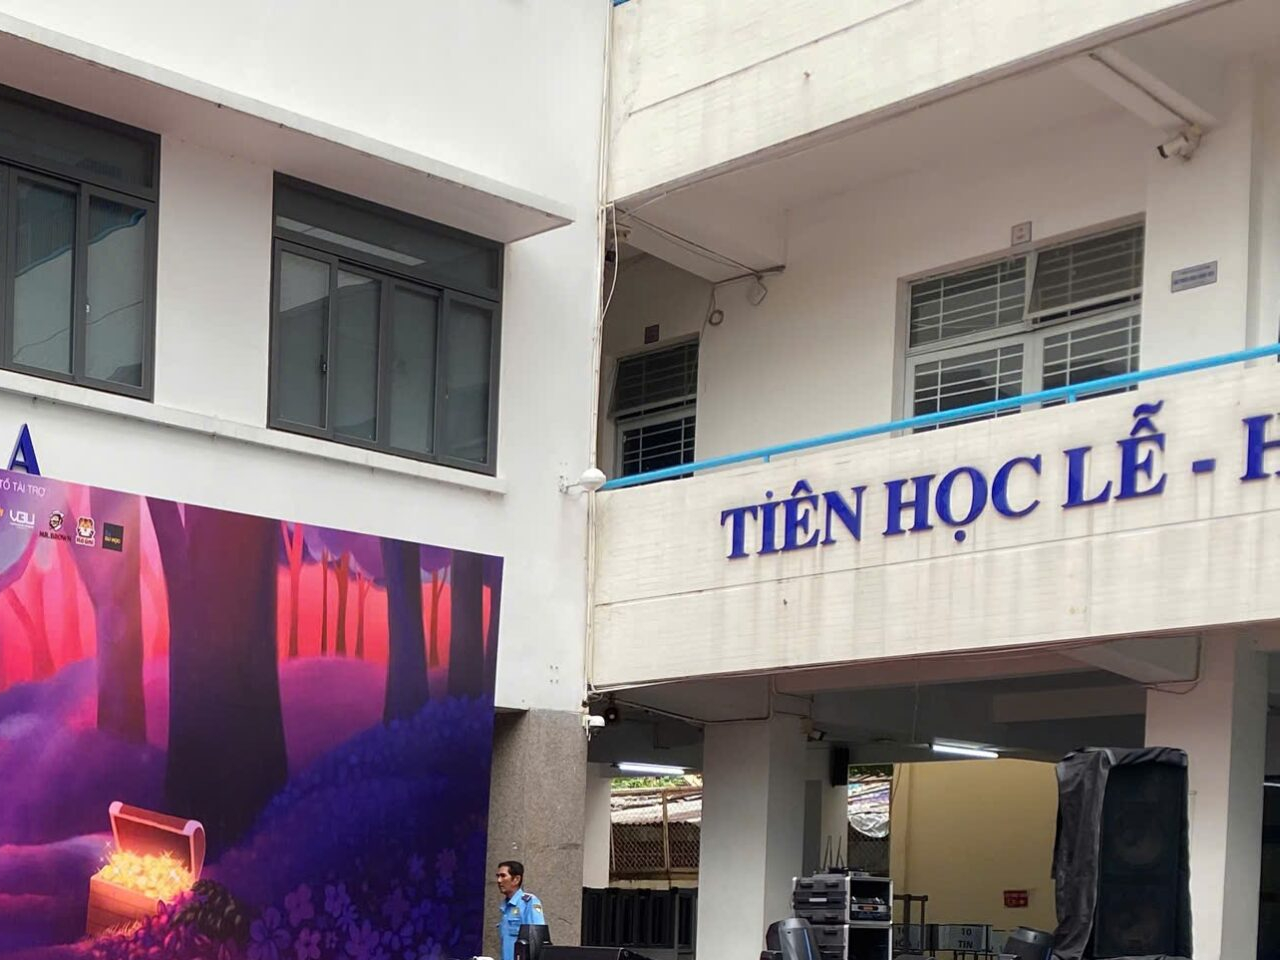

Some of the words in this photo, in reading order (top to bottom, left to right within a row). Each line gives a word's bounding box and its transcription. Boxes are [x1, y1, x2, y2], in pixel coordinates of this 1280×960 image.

[7, 423, 42, 477] A
[882, 453, 1042, 543] HỌC
[1062, 400, 1167, 511] LỄ
[13, 480, 26, 493] TÀI
[28, 485, 46, 498] TRỢ
